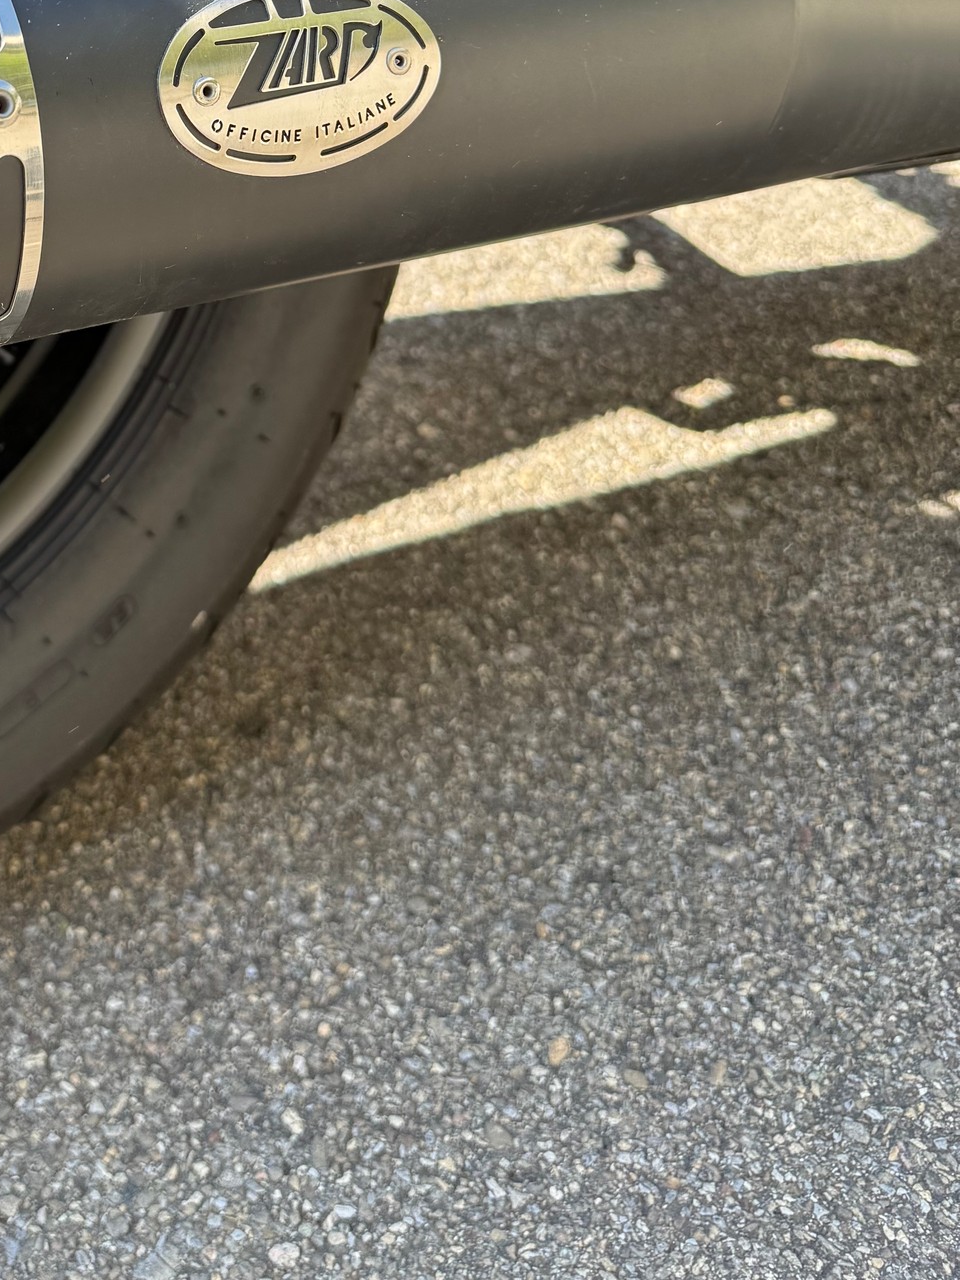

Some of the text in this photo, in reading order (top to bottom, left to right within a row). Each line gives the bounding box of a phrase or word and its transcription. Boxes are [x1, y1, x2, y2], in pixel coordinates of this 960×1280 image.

[214, 20, 383, 109] ZARD
[211, 93, 396, 143] OFFICINE ITALIANE
